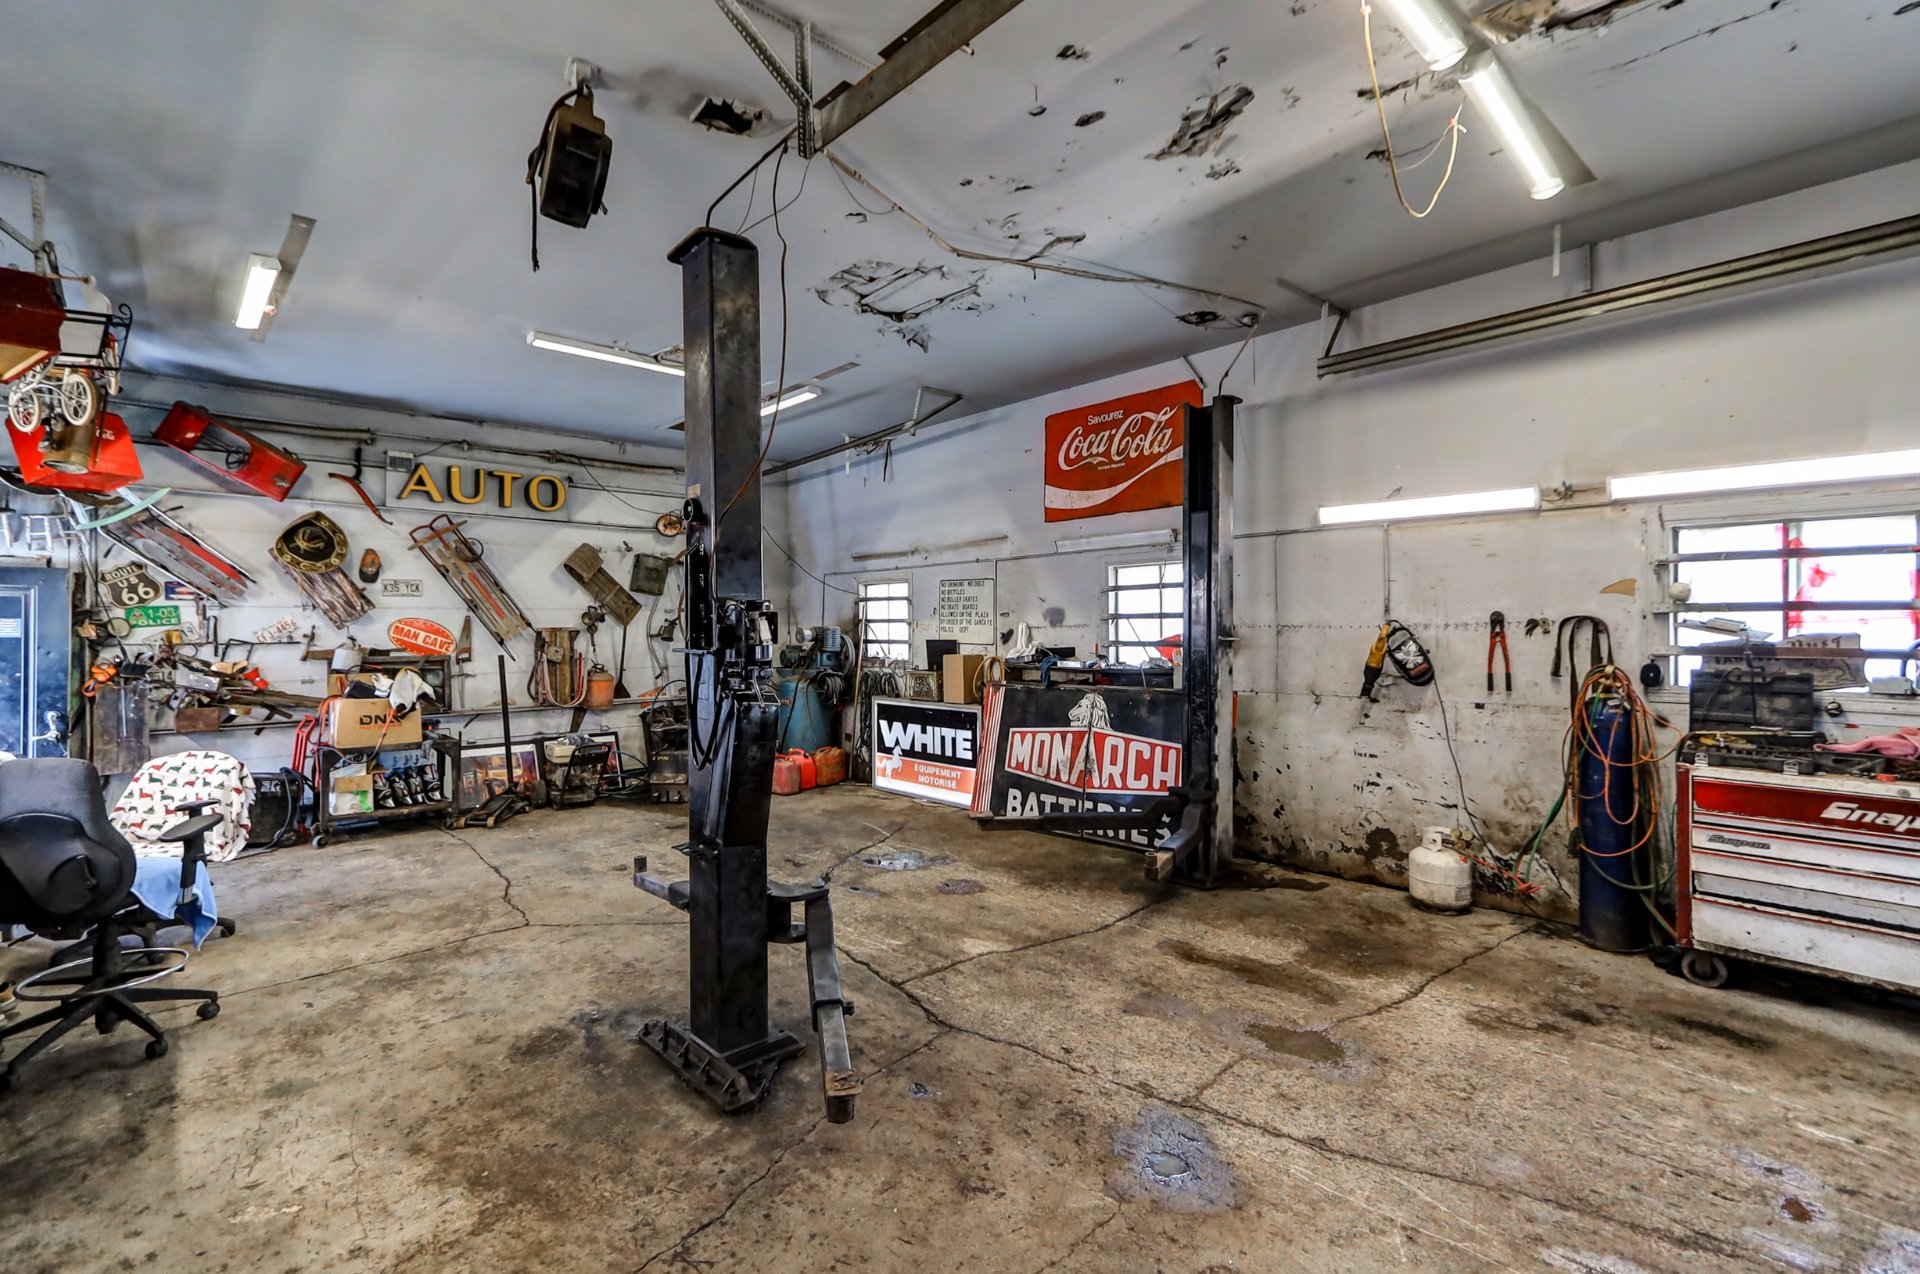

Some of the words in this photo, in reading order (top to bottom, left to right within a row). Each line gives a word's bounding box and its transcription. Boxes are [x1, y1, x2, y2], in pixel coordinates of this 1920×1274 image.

[1087, 410, 1124, 426] Savourez
[1058, 404, 1179, 471] Coca-Cola
[397, 462, 567, 512] AUTO
[103, 564, 138, 581] ROUTE
[121, 582, 155, 605] 66
[130, 618, 179, 626] POLICE
[392, 625, 420, 642] MAN
[422, 635, 454, 653] CAVE
[879, 720, 973, 760] WHITE
[914, 763, 961, 779] ÉQUIPEMENT
[1011, 732, 1176, 790] MONARCH
[918, 774, 956, 788] MOTORISÉ
